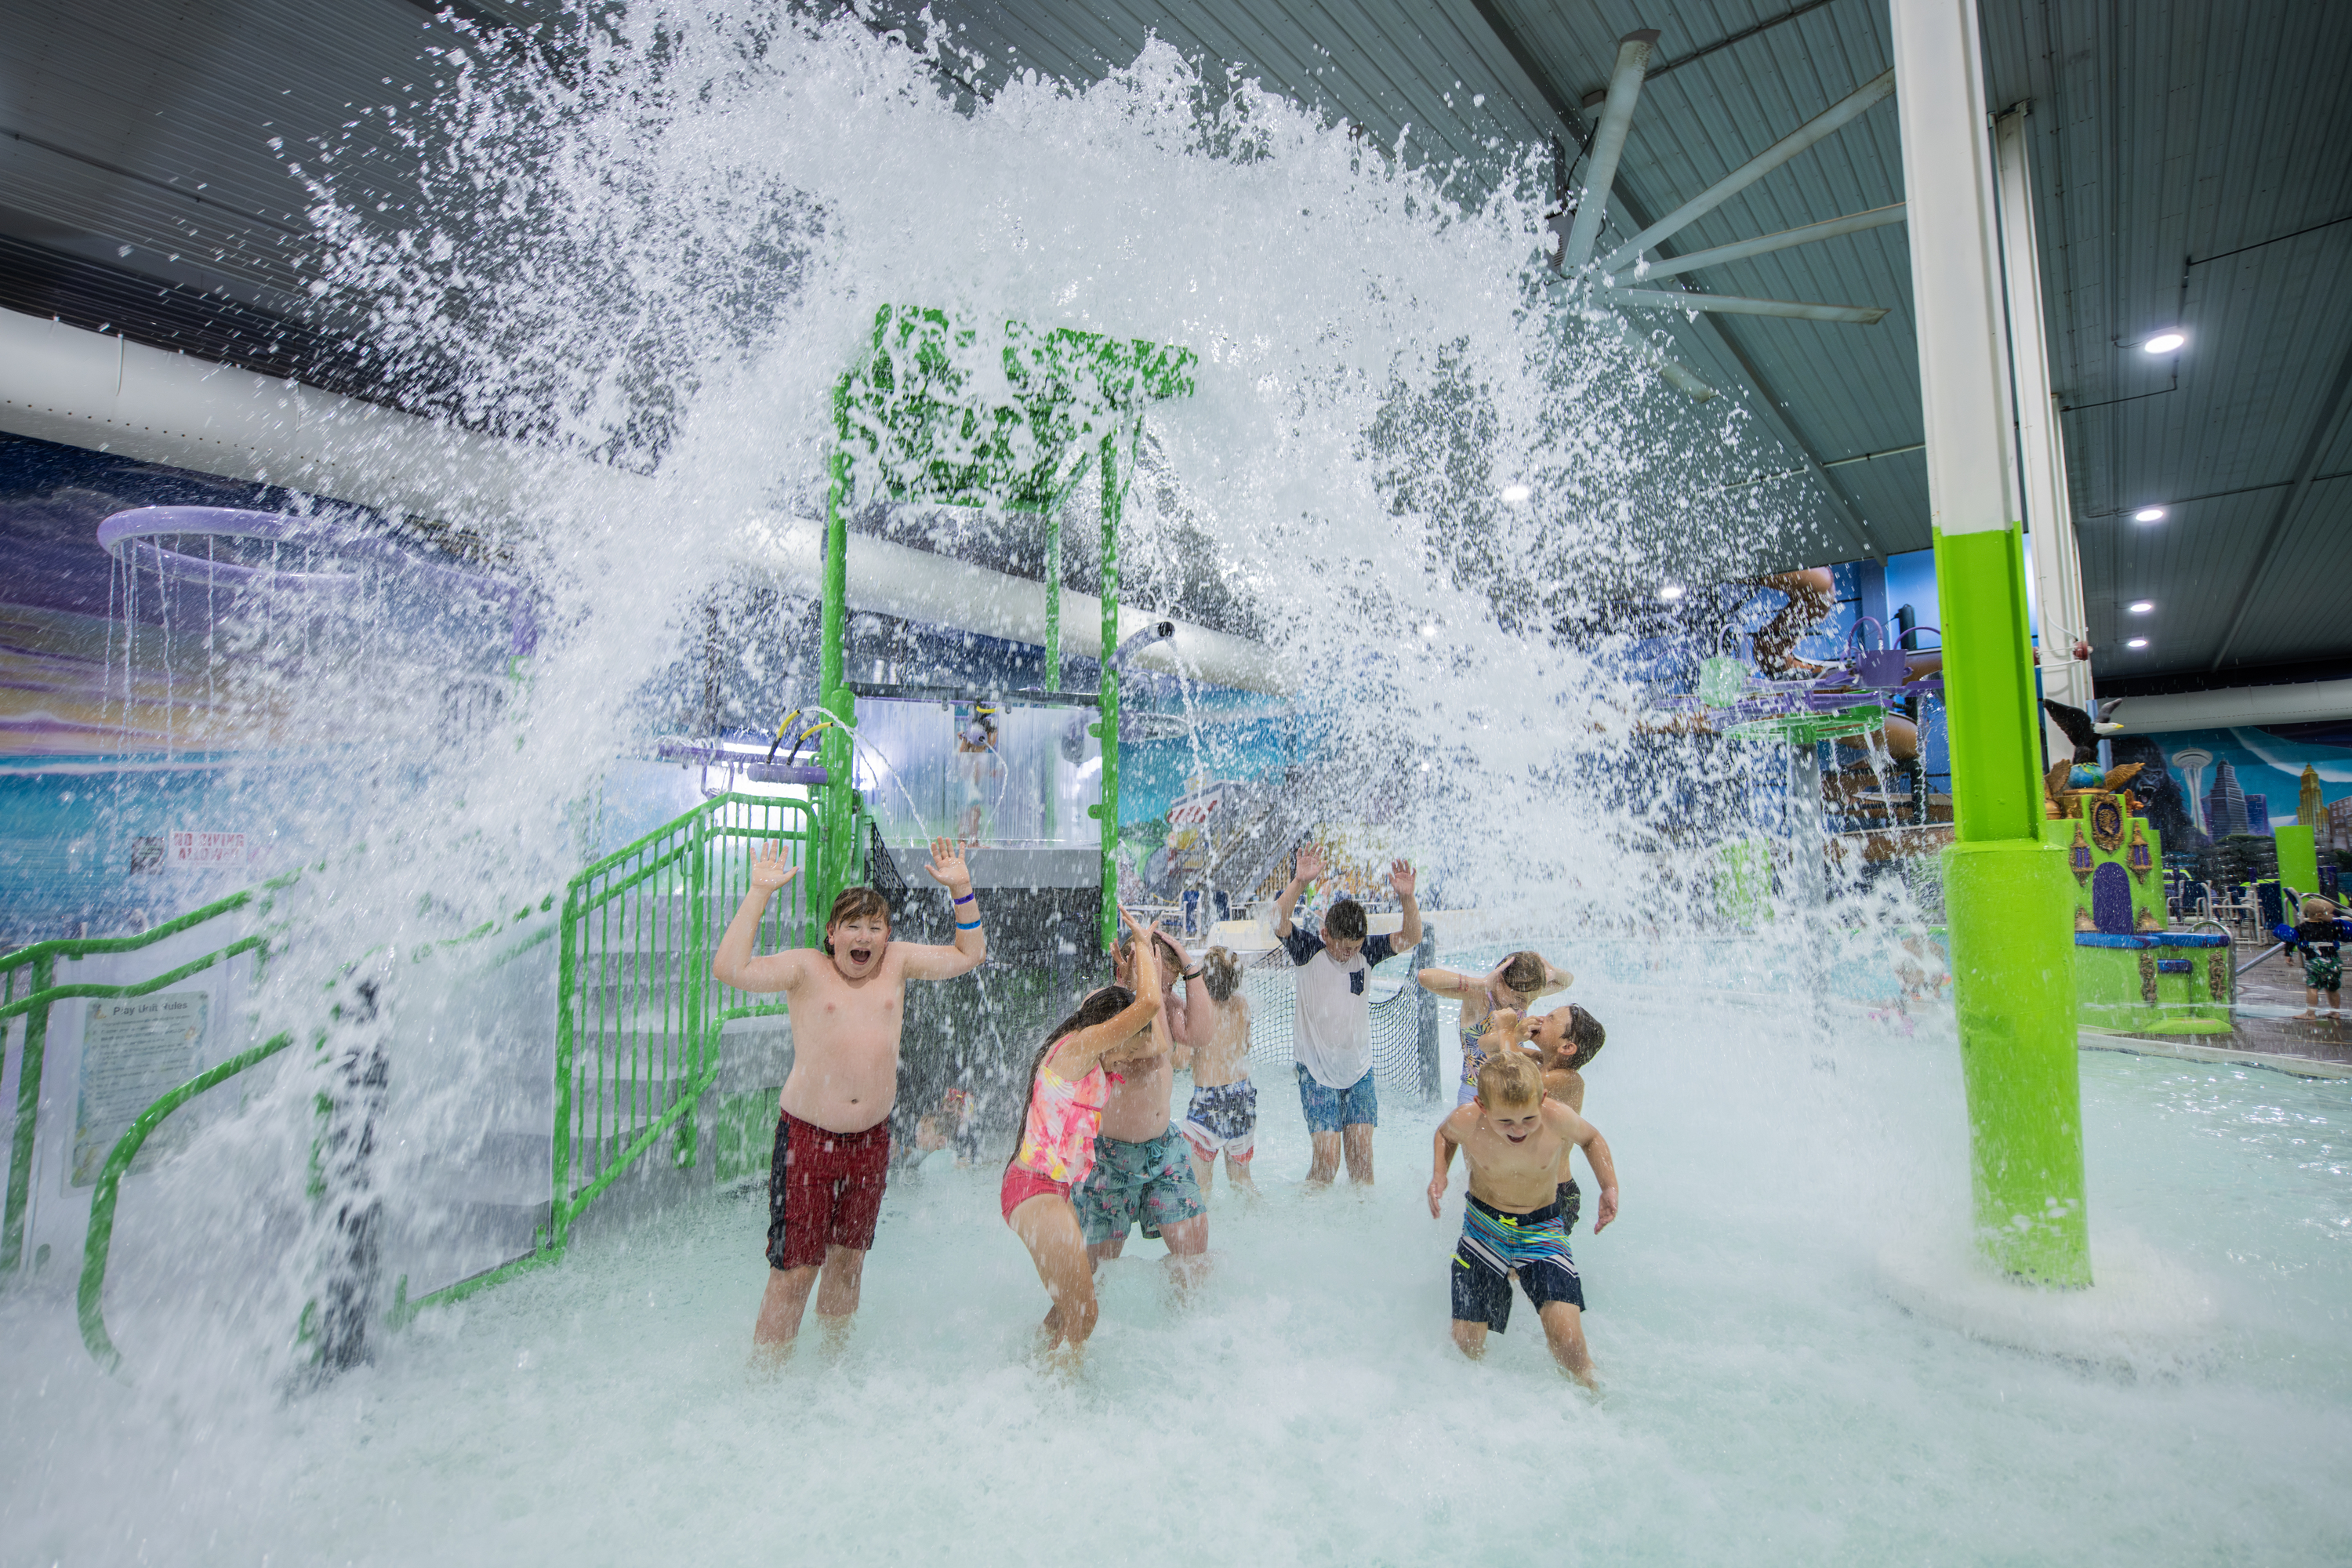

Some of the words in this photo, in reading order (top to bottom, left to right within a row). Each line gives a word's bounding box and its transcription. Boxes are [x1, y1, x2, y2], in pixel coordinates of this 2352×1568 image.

[174, 833, 193, 846] NO
[199, 833, 244, 847] DIVING
[113, 1005, 136, 1016] Play
